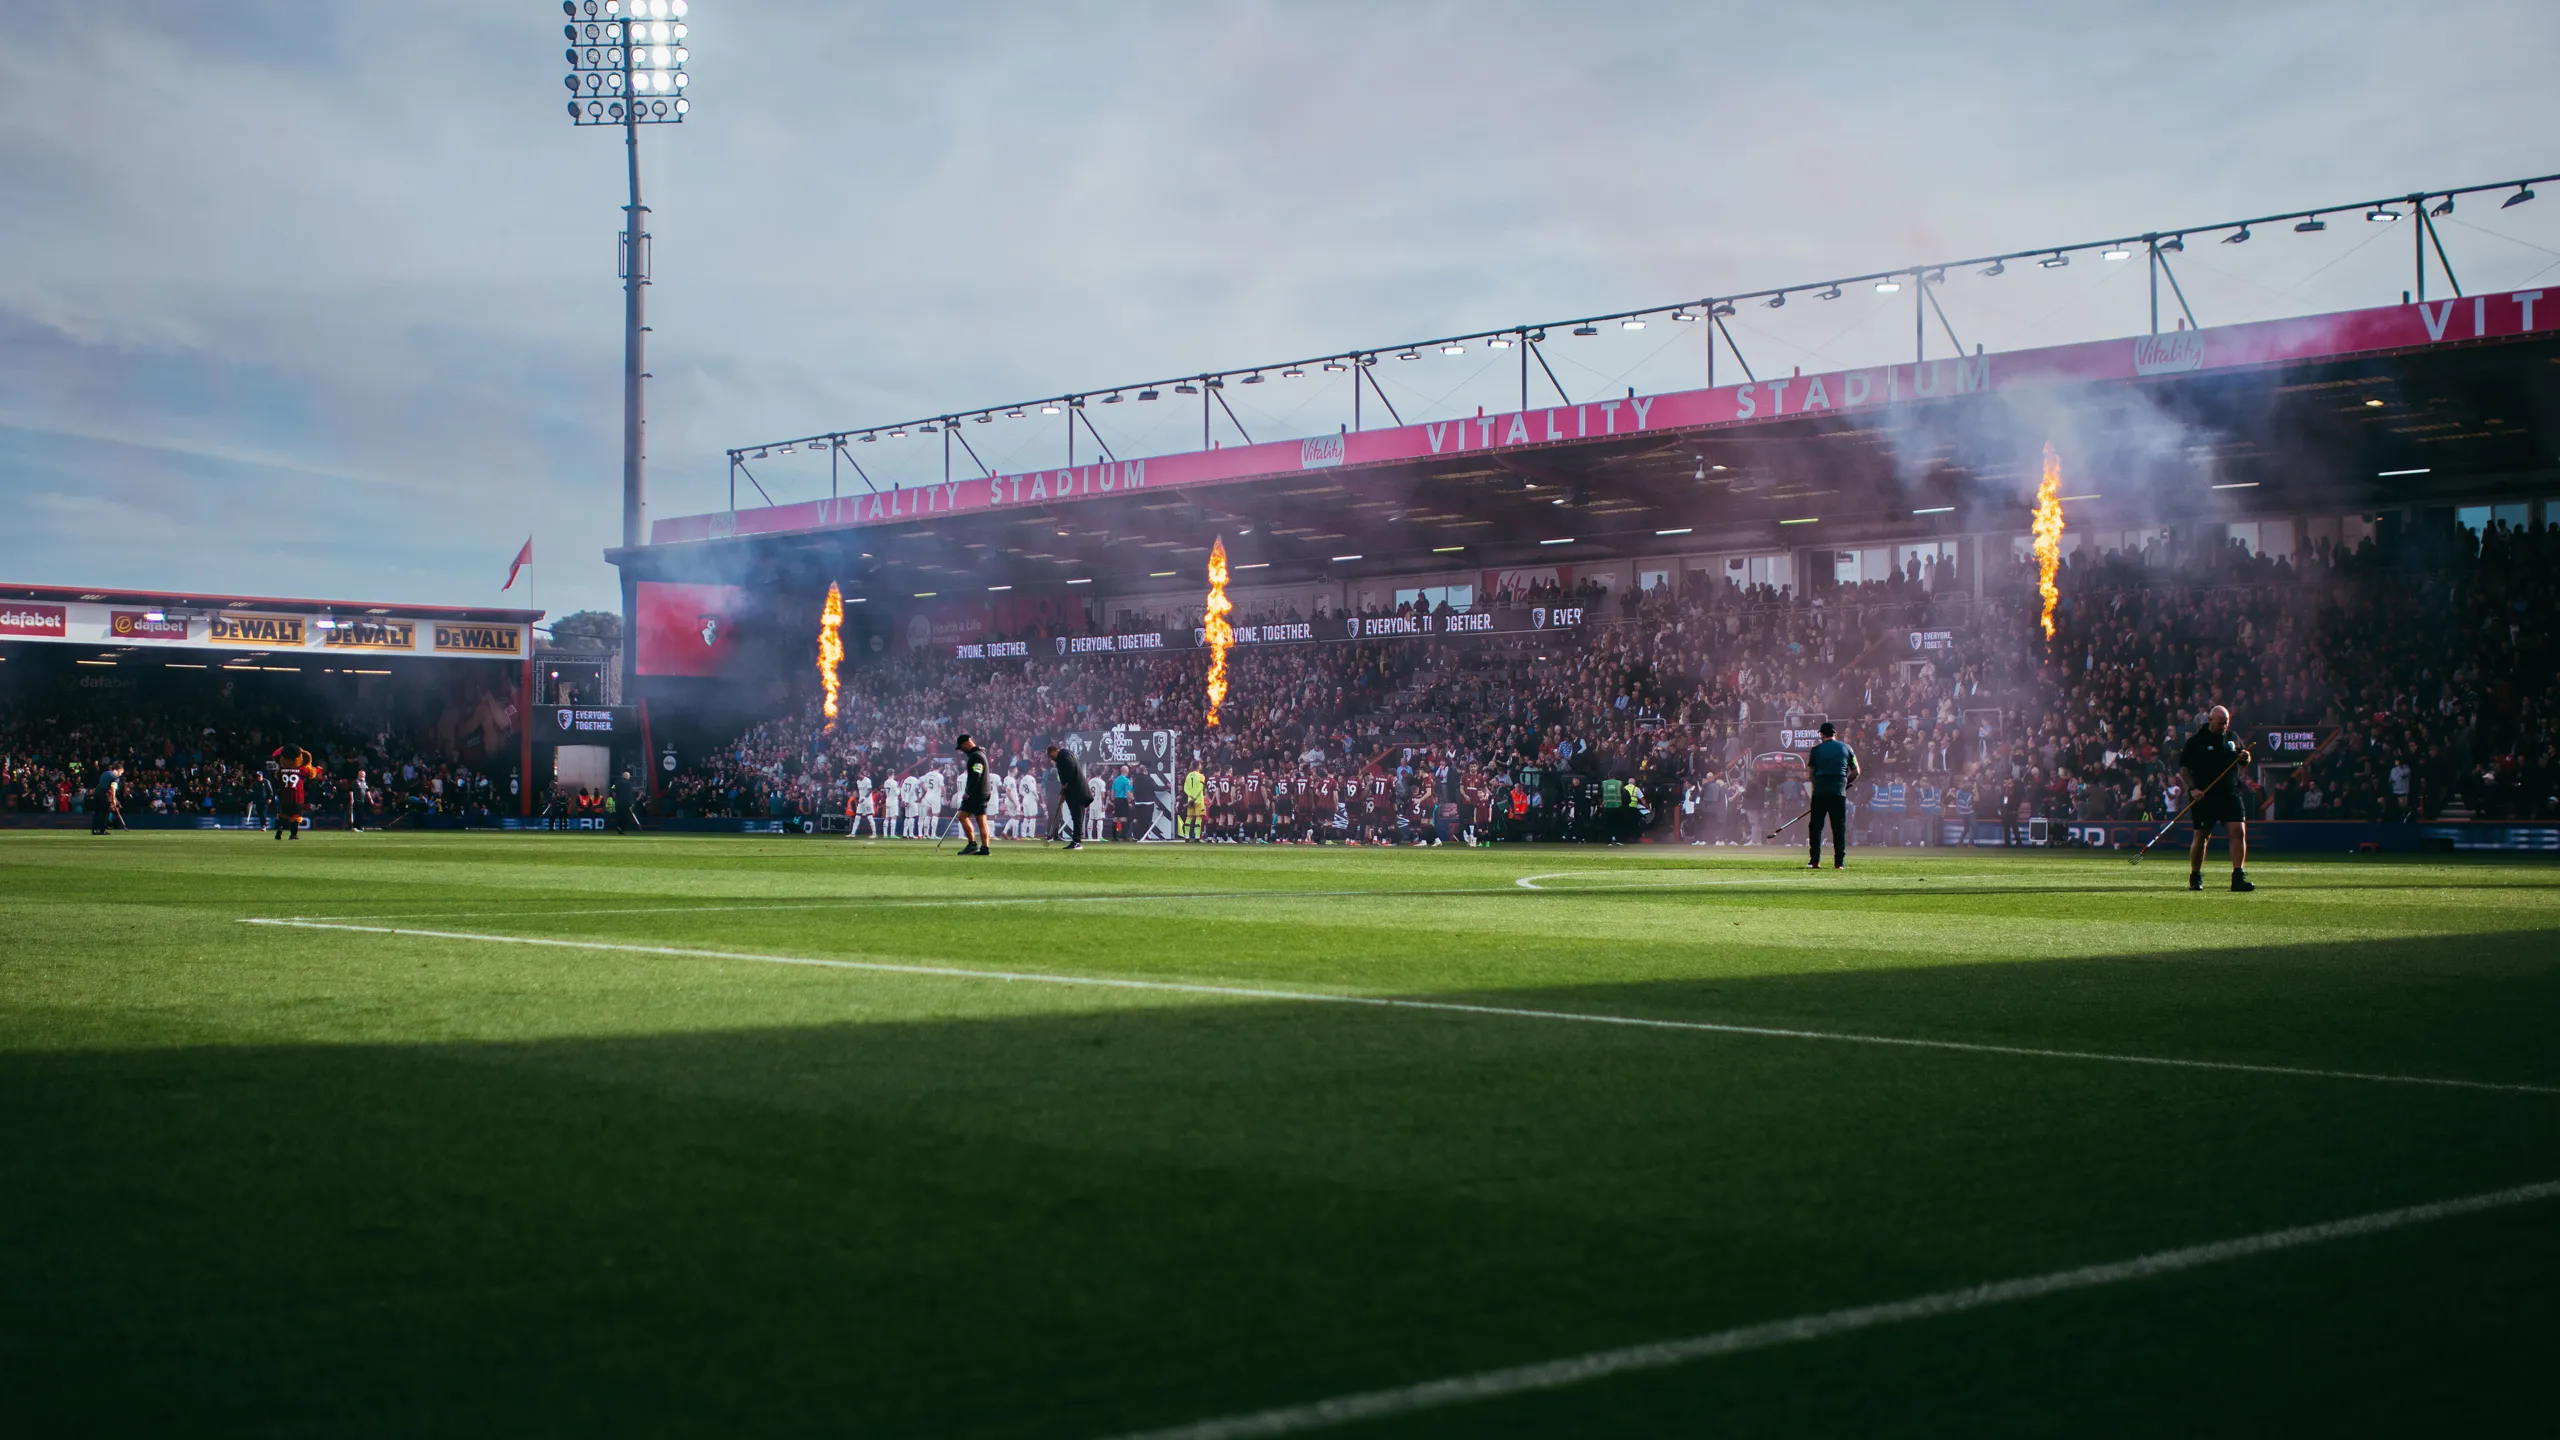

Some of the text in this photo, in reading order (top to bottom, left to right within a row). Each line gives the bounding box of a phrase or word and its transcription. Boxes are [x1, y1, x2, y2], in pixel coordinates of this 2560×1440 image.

[2419, 291, 2542, 341] VIT
[2137, 337, 2201, 370] Vitality
[1426, 356, 1991, 454] VITALITY STADIUM
[1303, 437, 1343, 464] Vitality
[816, 460, 1145, 524] VITALITY STADIUM
[0, 611, 61, 629] dafabet
[1366, 616, 1420, 635] EVERYONE,
[435, 627, 518, 649] DEWALT
[1262, 623, 1313, 640] TOGETHER.
[1923, 631, 1953, 640] EVERYONE,
[986, 641, 1029, 658] TOGETHER.
[1071, 633, 1164, 652] EVERYONE, TOGETHER.
[575, 721, 613, 731] TOGETHER.
[1114, 731, 1125, 740] No
[2284, 741, 2316, 751] TOGETHER.
[281, 774, 300, 789] 99
[928, 779, 934, 790] 5
[1206, 780, 1217, 793] 25
[1219, 781, 1230, 793] 10
[1247, 779, 1259, 792] 27
[1278, 782, 1288, 795] 15
[1297, 782, 1306, 795] 17
[1375, 781, 1385, 795] 11
[1320, 785, 1328, 796] 4
[1346, 784, 1357, 797] 19
